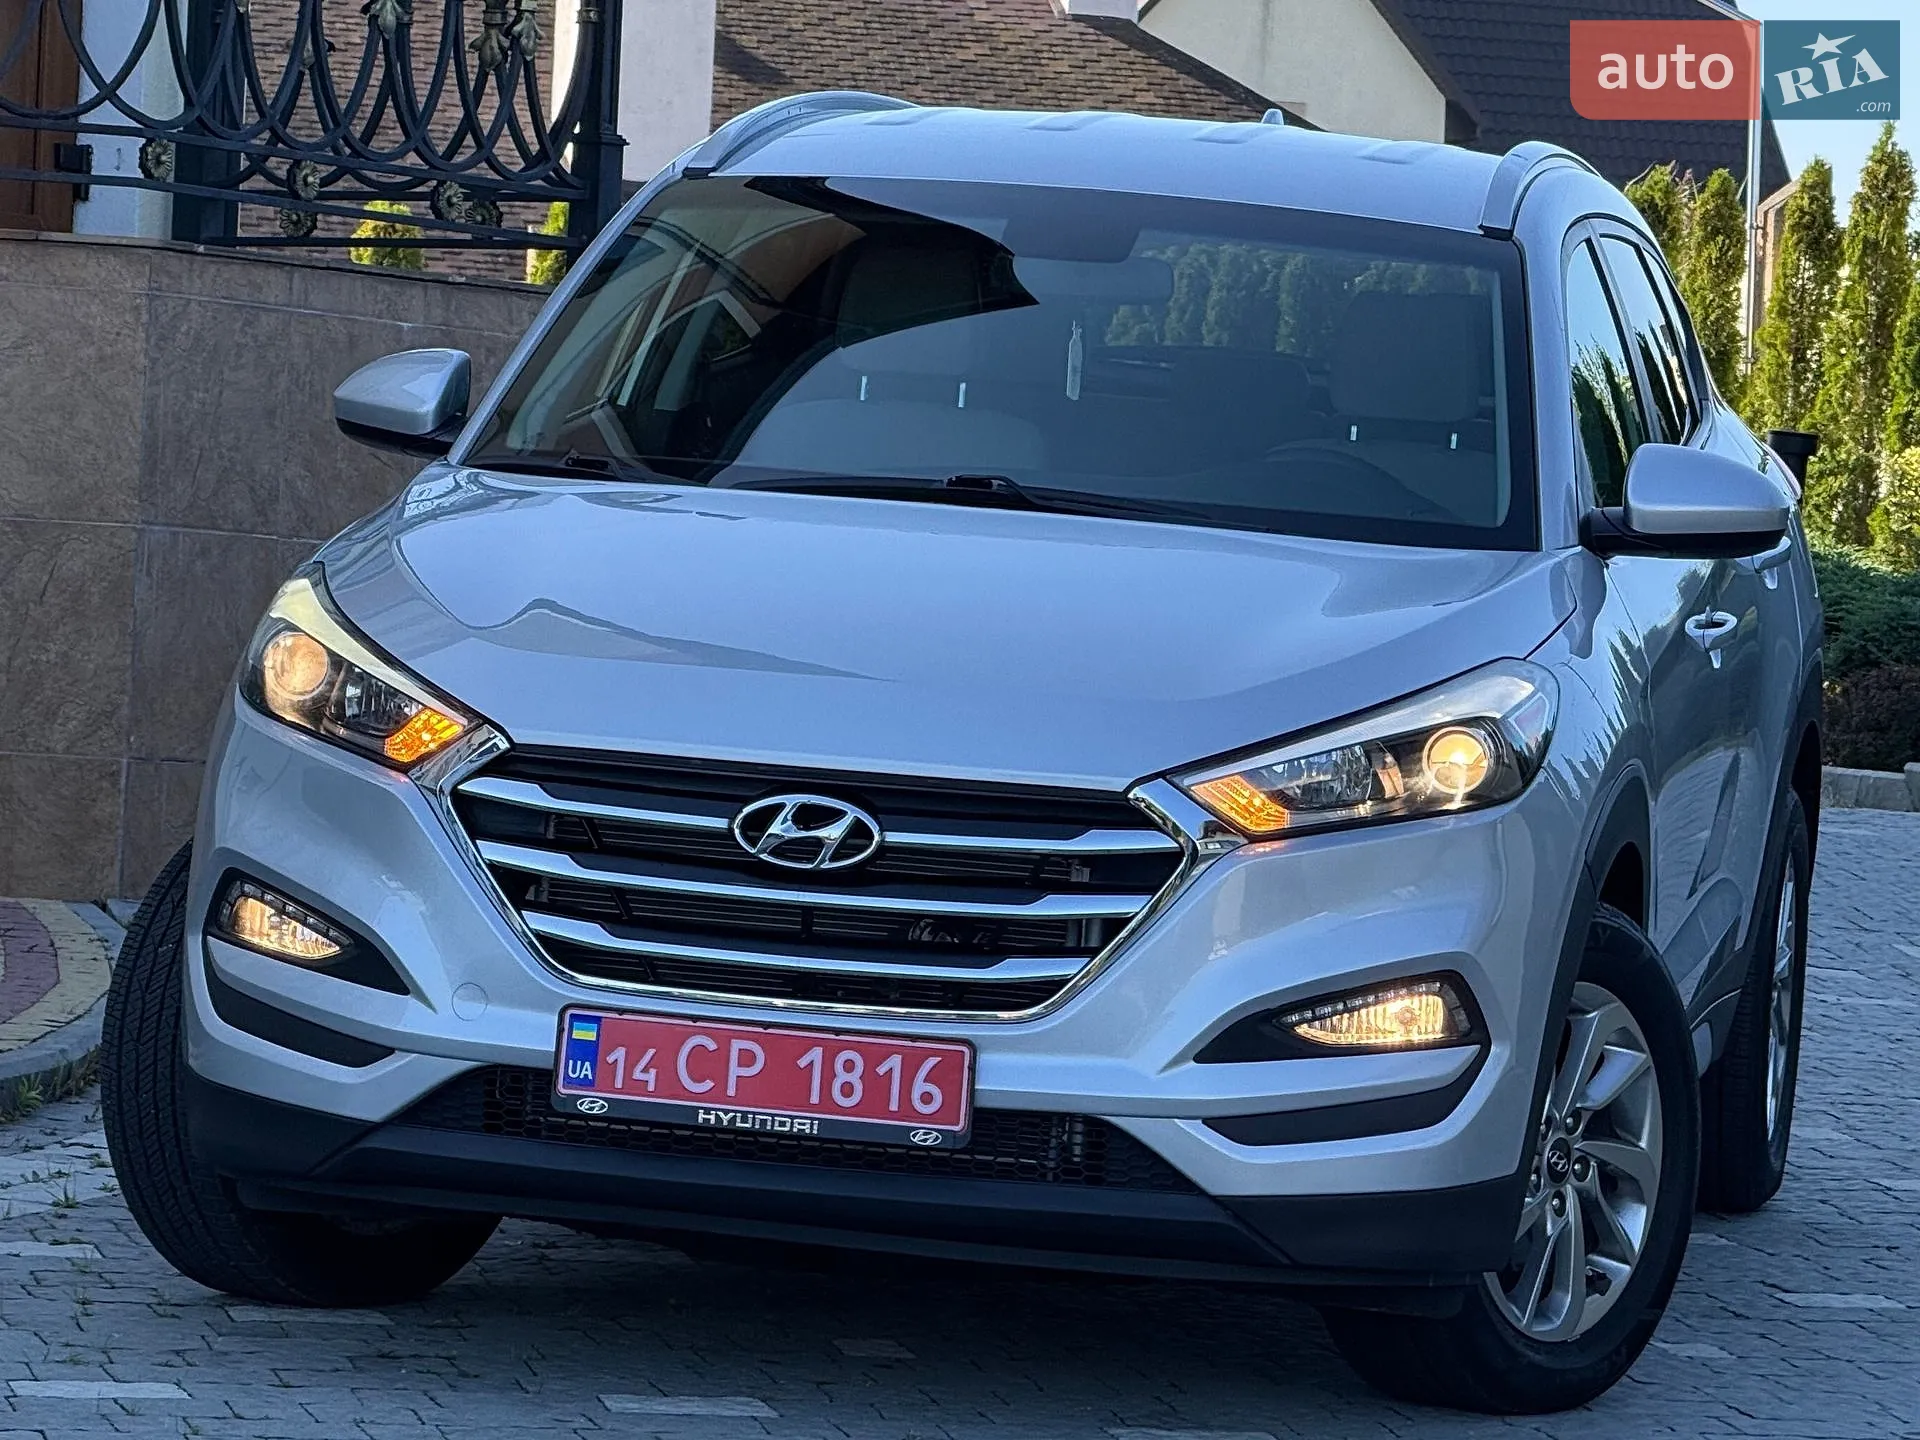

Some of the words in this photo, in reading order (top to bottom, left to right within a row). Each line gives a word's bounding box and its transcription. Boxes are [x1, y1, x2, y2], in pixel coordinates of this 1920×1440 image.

[568, 1059, 593, 1081] UA
[606, 1046, 657, 1092] 14
[676, 1035, 766, 1097] CP
[796, 1047, 943, 1115] 1816
[697, 1109, 819, 1135] HYUNDAI
